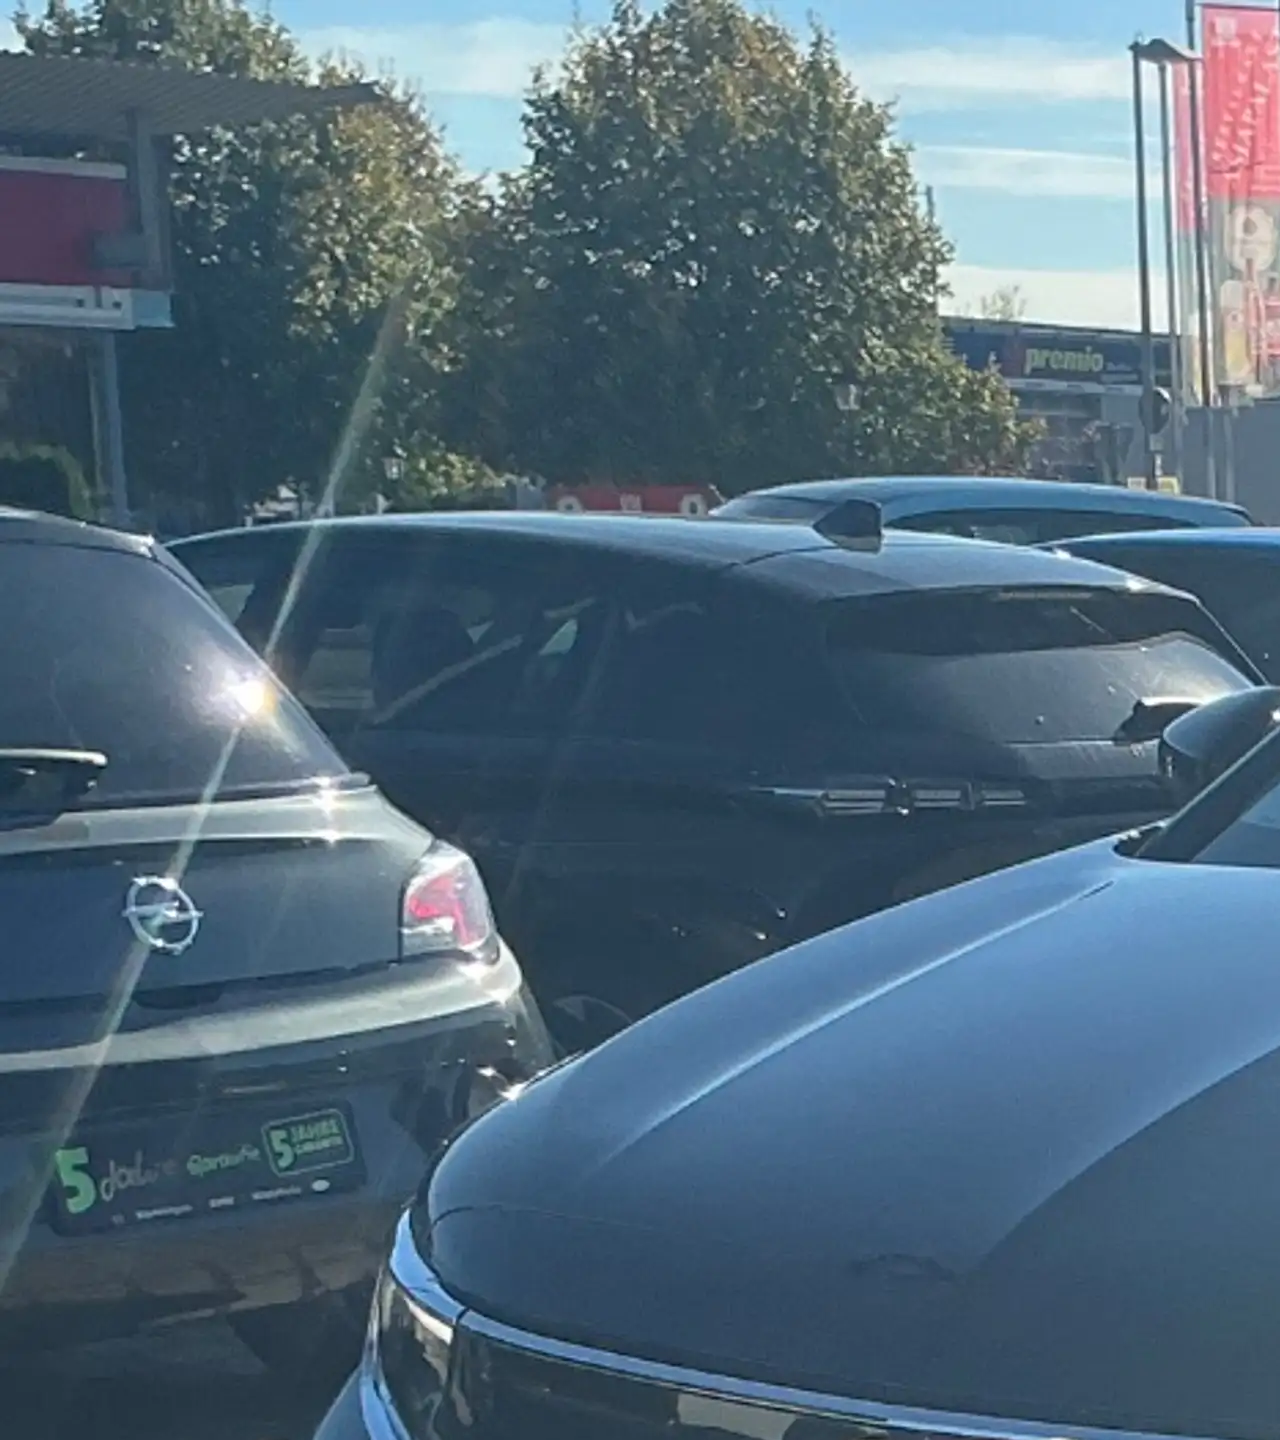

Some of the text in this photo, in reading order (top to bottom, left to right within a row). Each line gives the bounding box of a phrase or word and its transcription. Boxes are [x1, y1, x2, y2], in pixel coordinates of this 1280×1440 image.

[1023, 345, 1104, 375] premio
[269, 1129, 293, 1169] 5
[55, 1146, 96, 1214] 5
